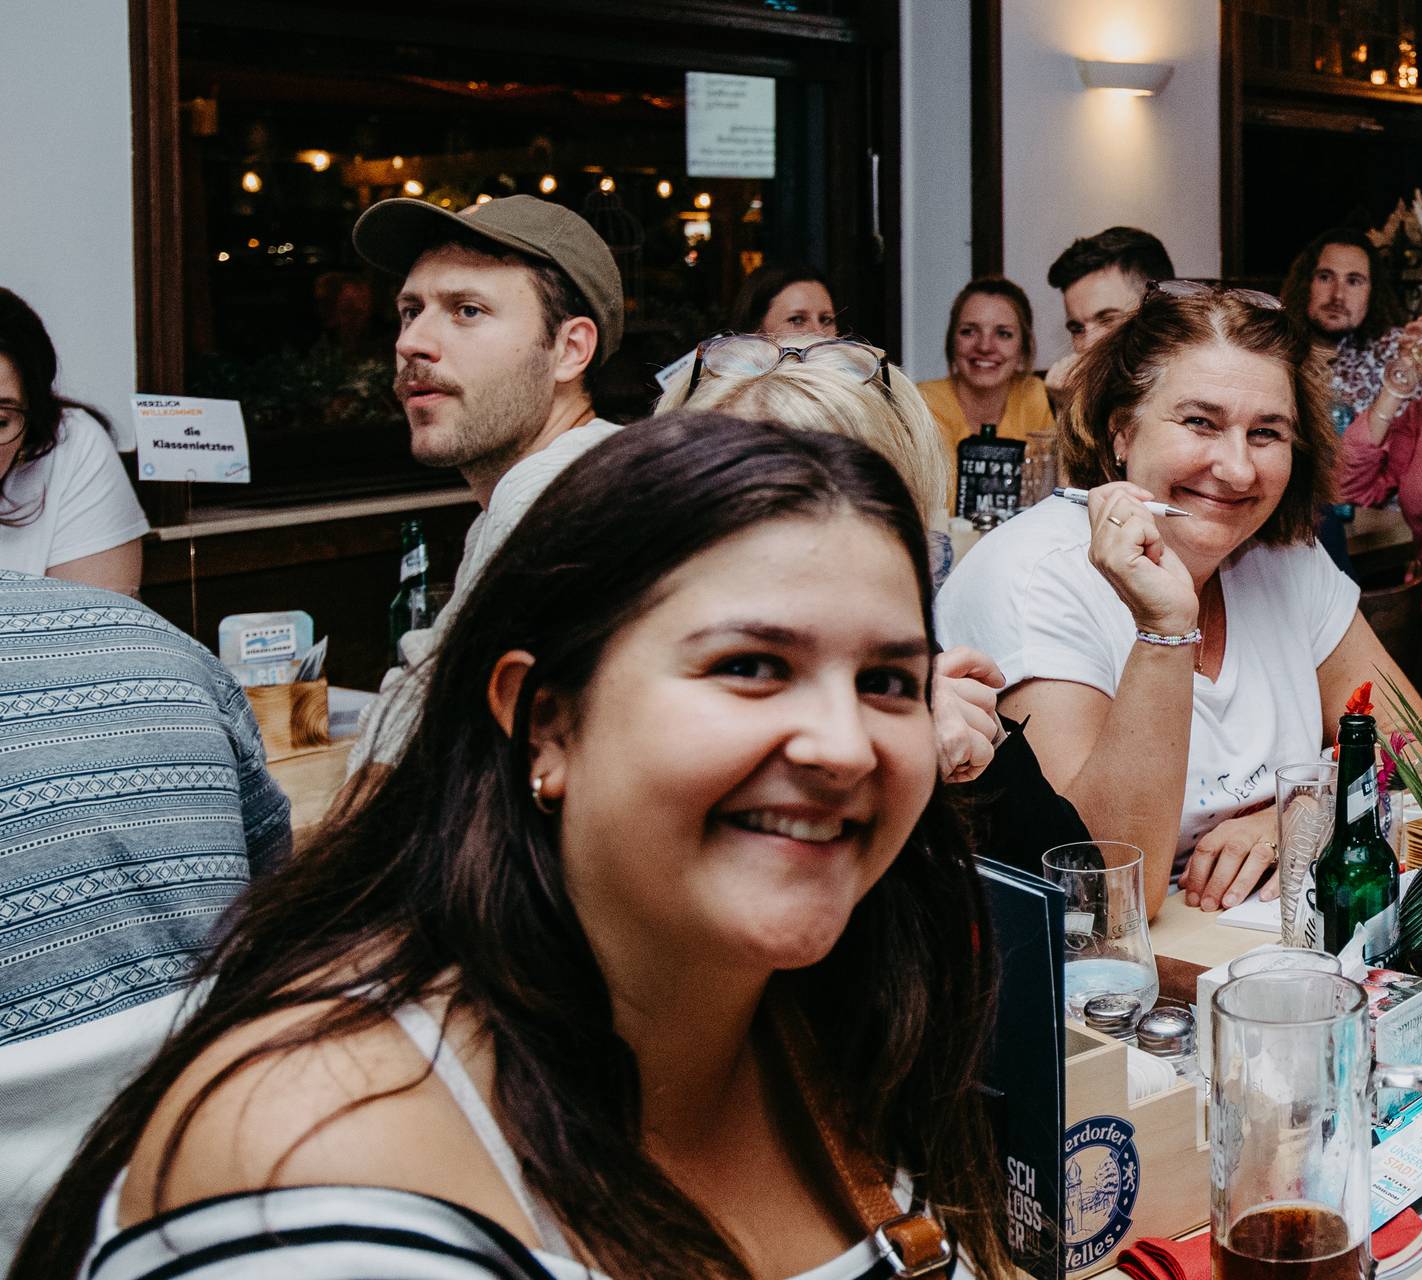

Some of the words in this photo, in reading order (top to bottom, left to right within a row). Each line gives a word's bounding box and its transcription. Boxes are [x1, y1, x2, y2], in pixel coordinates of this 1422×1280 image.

[183, 426, 201, 436] die
[152, 439, 235, 452] Klassenletzten
[1064, 1122, 1127, 1153] erdorfer
[1007, 1155, 1036, 1198] SCH
